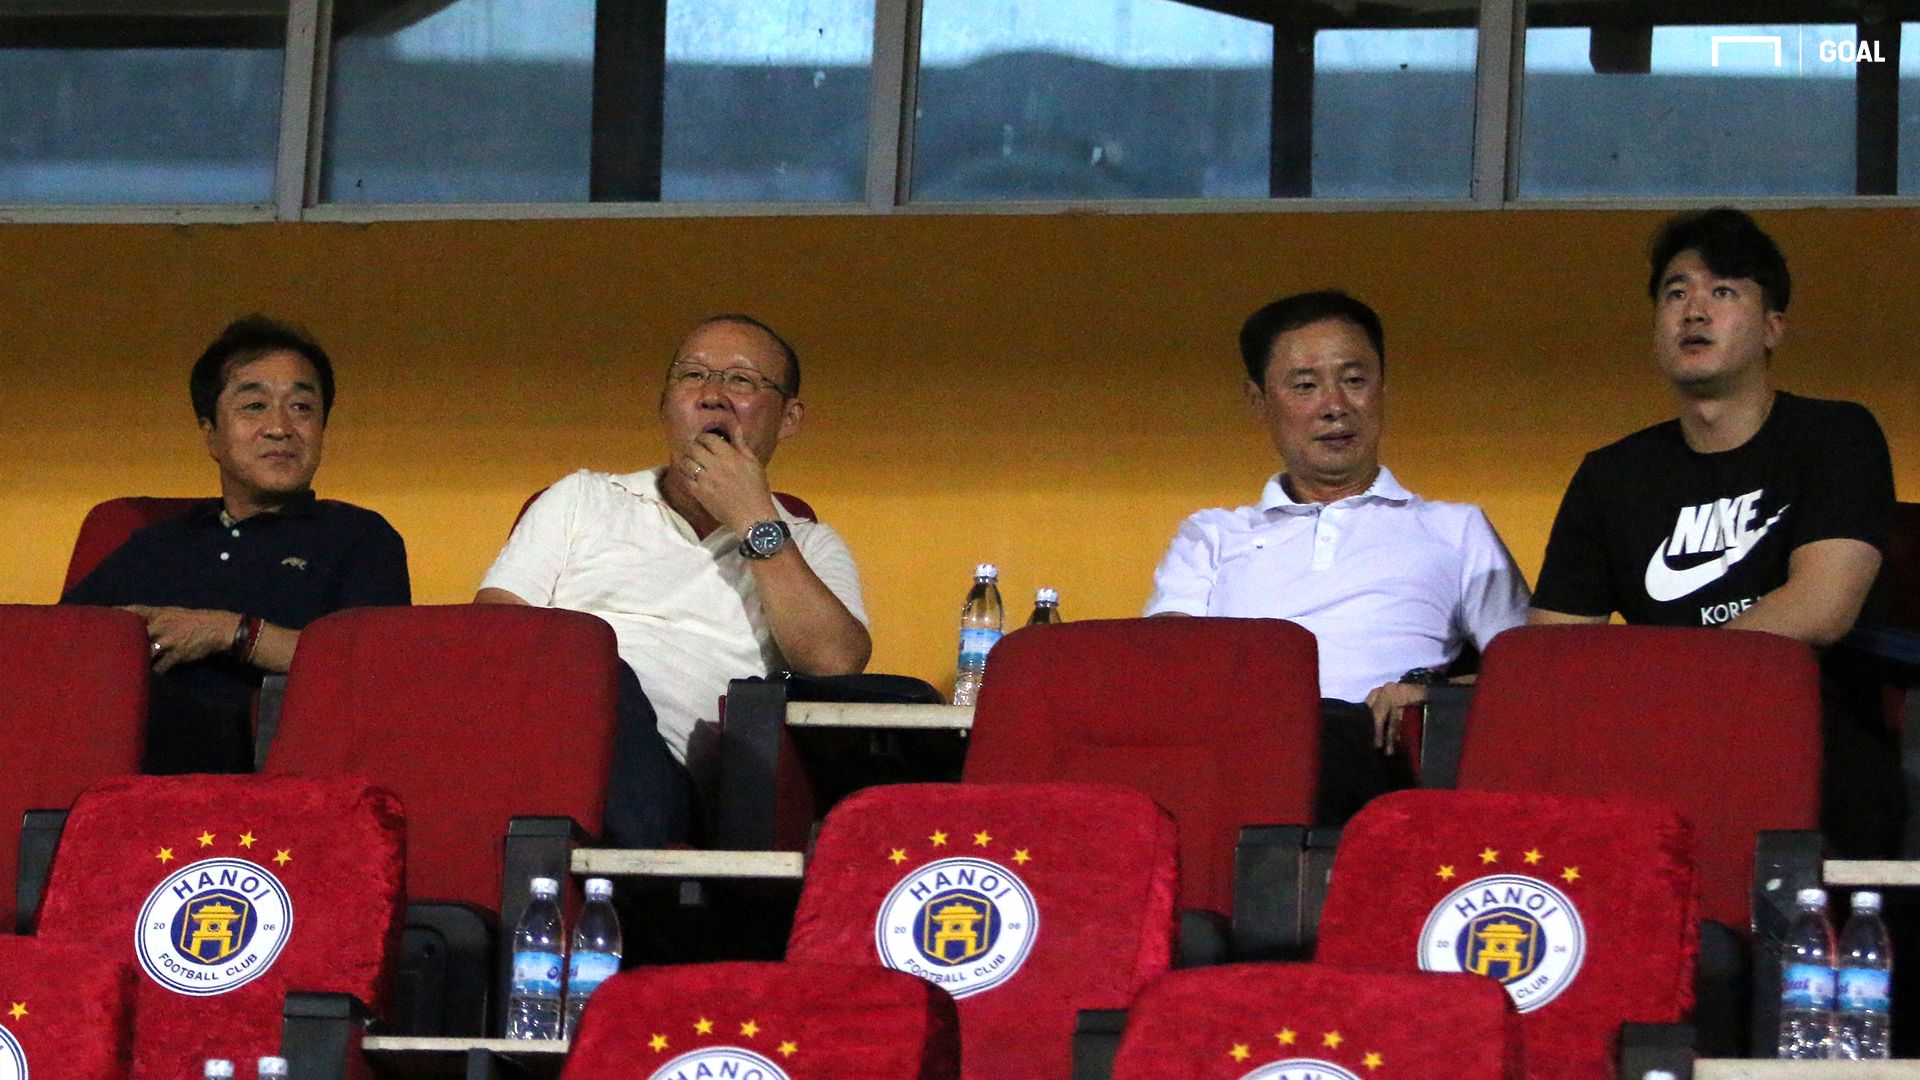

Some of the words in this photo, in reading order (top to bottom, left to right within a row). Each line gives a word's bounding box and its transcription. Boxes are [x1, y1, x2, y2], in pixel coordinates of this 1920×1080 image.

[1666, 488, 1764, 556] NIKE
[1700, 598, 1761, 625] KORE
[172, 869, 271, 901] HANOI
[909, 868, 1011, 901] HANOI
[1455, 887, 1558, 919] HANOI
[153, 922, 166, 930] 20
[158, 952, 219, 981] FOOTBALL
[225, 953, 258, 976] CLUB
[904, 958, 966, 984] FOOTBALL
[974, 953, 1006, 977] CLUB
[1516, 974, 1549, 999] CLUB
